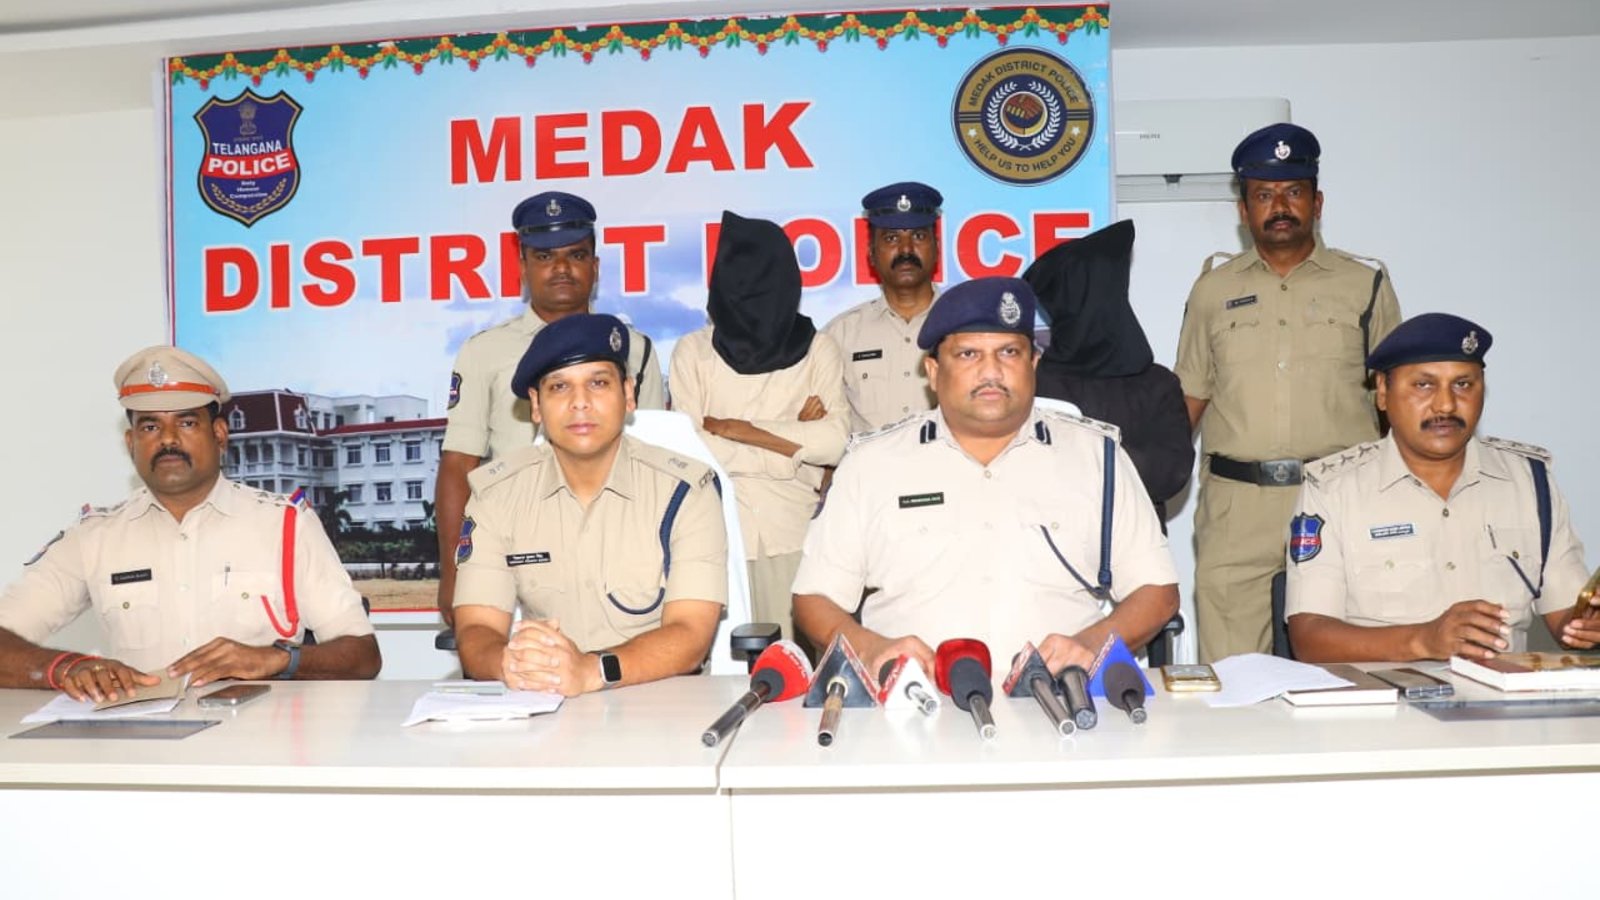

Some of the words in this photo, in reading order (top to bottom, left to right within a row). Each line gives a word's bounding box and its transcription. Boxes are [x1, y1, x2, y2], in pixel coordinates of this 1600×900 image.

[968, 72, 996, 106] MEDAK
[995, 60, 1048, 76] DISTRICT
[1048, 69, 1080, 103] POLICE
[208, 152, 291, 175] POLICE
[212, 140, 283, 155] TELANGANA
[452, 102, 811, 184] MEDAK
[974, 139, 997, 161] HELP
[998, 158, 1012, 170] US
[1015, 163, 1030, 173] TO
[1033, 154, 1058, 171] HELP
[1058, 137, 1077, 157] YOU
[206, 226, 664, 312] DISTRIT
[706, 213, 1089, 290] OLC
